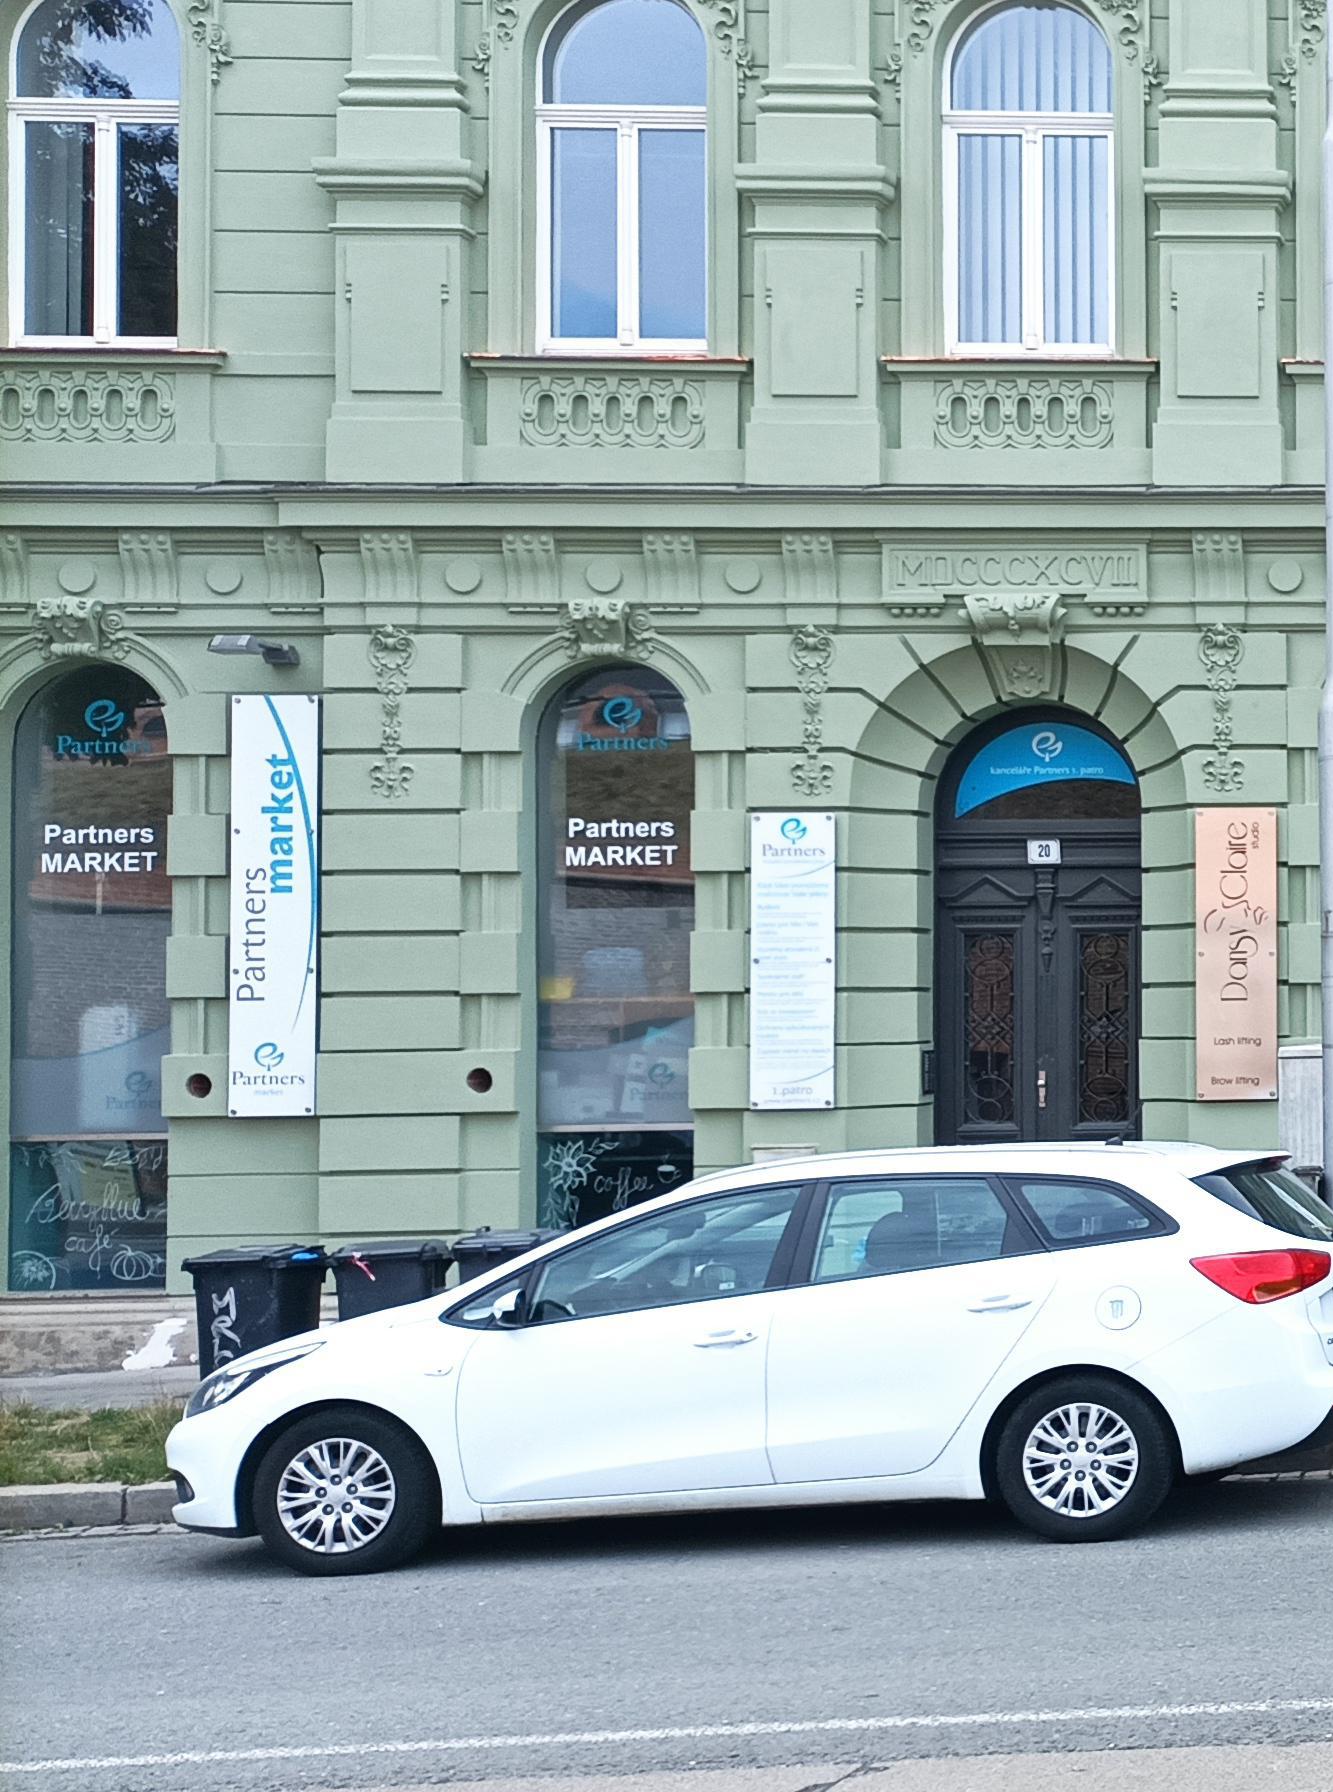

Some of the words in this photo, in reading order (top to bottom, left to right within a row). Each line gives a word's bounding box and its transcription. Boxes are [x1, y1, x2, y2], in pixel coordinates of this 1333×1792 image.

[57, 734, 151, 755] Partners
[577, 733, 669, 752] Partners
[261, 753, 294, 894] market
[568, 818, 675, 838] Partners
[44, 824, 154, 845] Partners
[1251, 821, 1260, 849] studio
[565, 844, 678, 867] MARKET
[762, 844, 826, 857] Partners
[1037, 844, 1051, 858] 20
[1220, 822, 1248, 900] Claire
[41, 852, 158, 873] MARKET
[237, 867, 266, 1002] Partners
[1213, 1037, 1234, 1046] Lash
[1237, 1037, 1261, 1048] lifting
[232, 1071, 306, 1086] Partners
[1211, 1076, 1232, 1085] Brow
[1235, 1076, 1260, 1087] lifting
